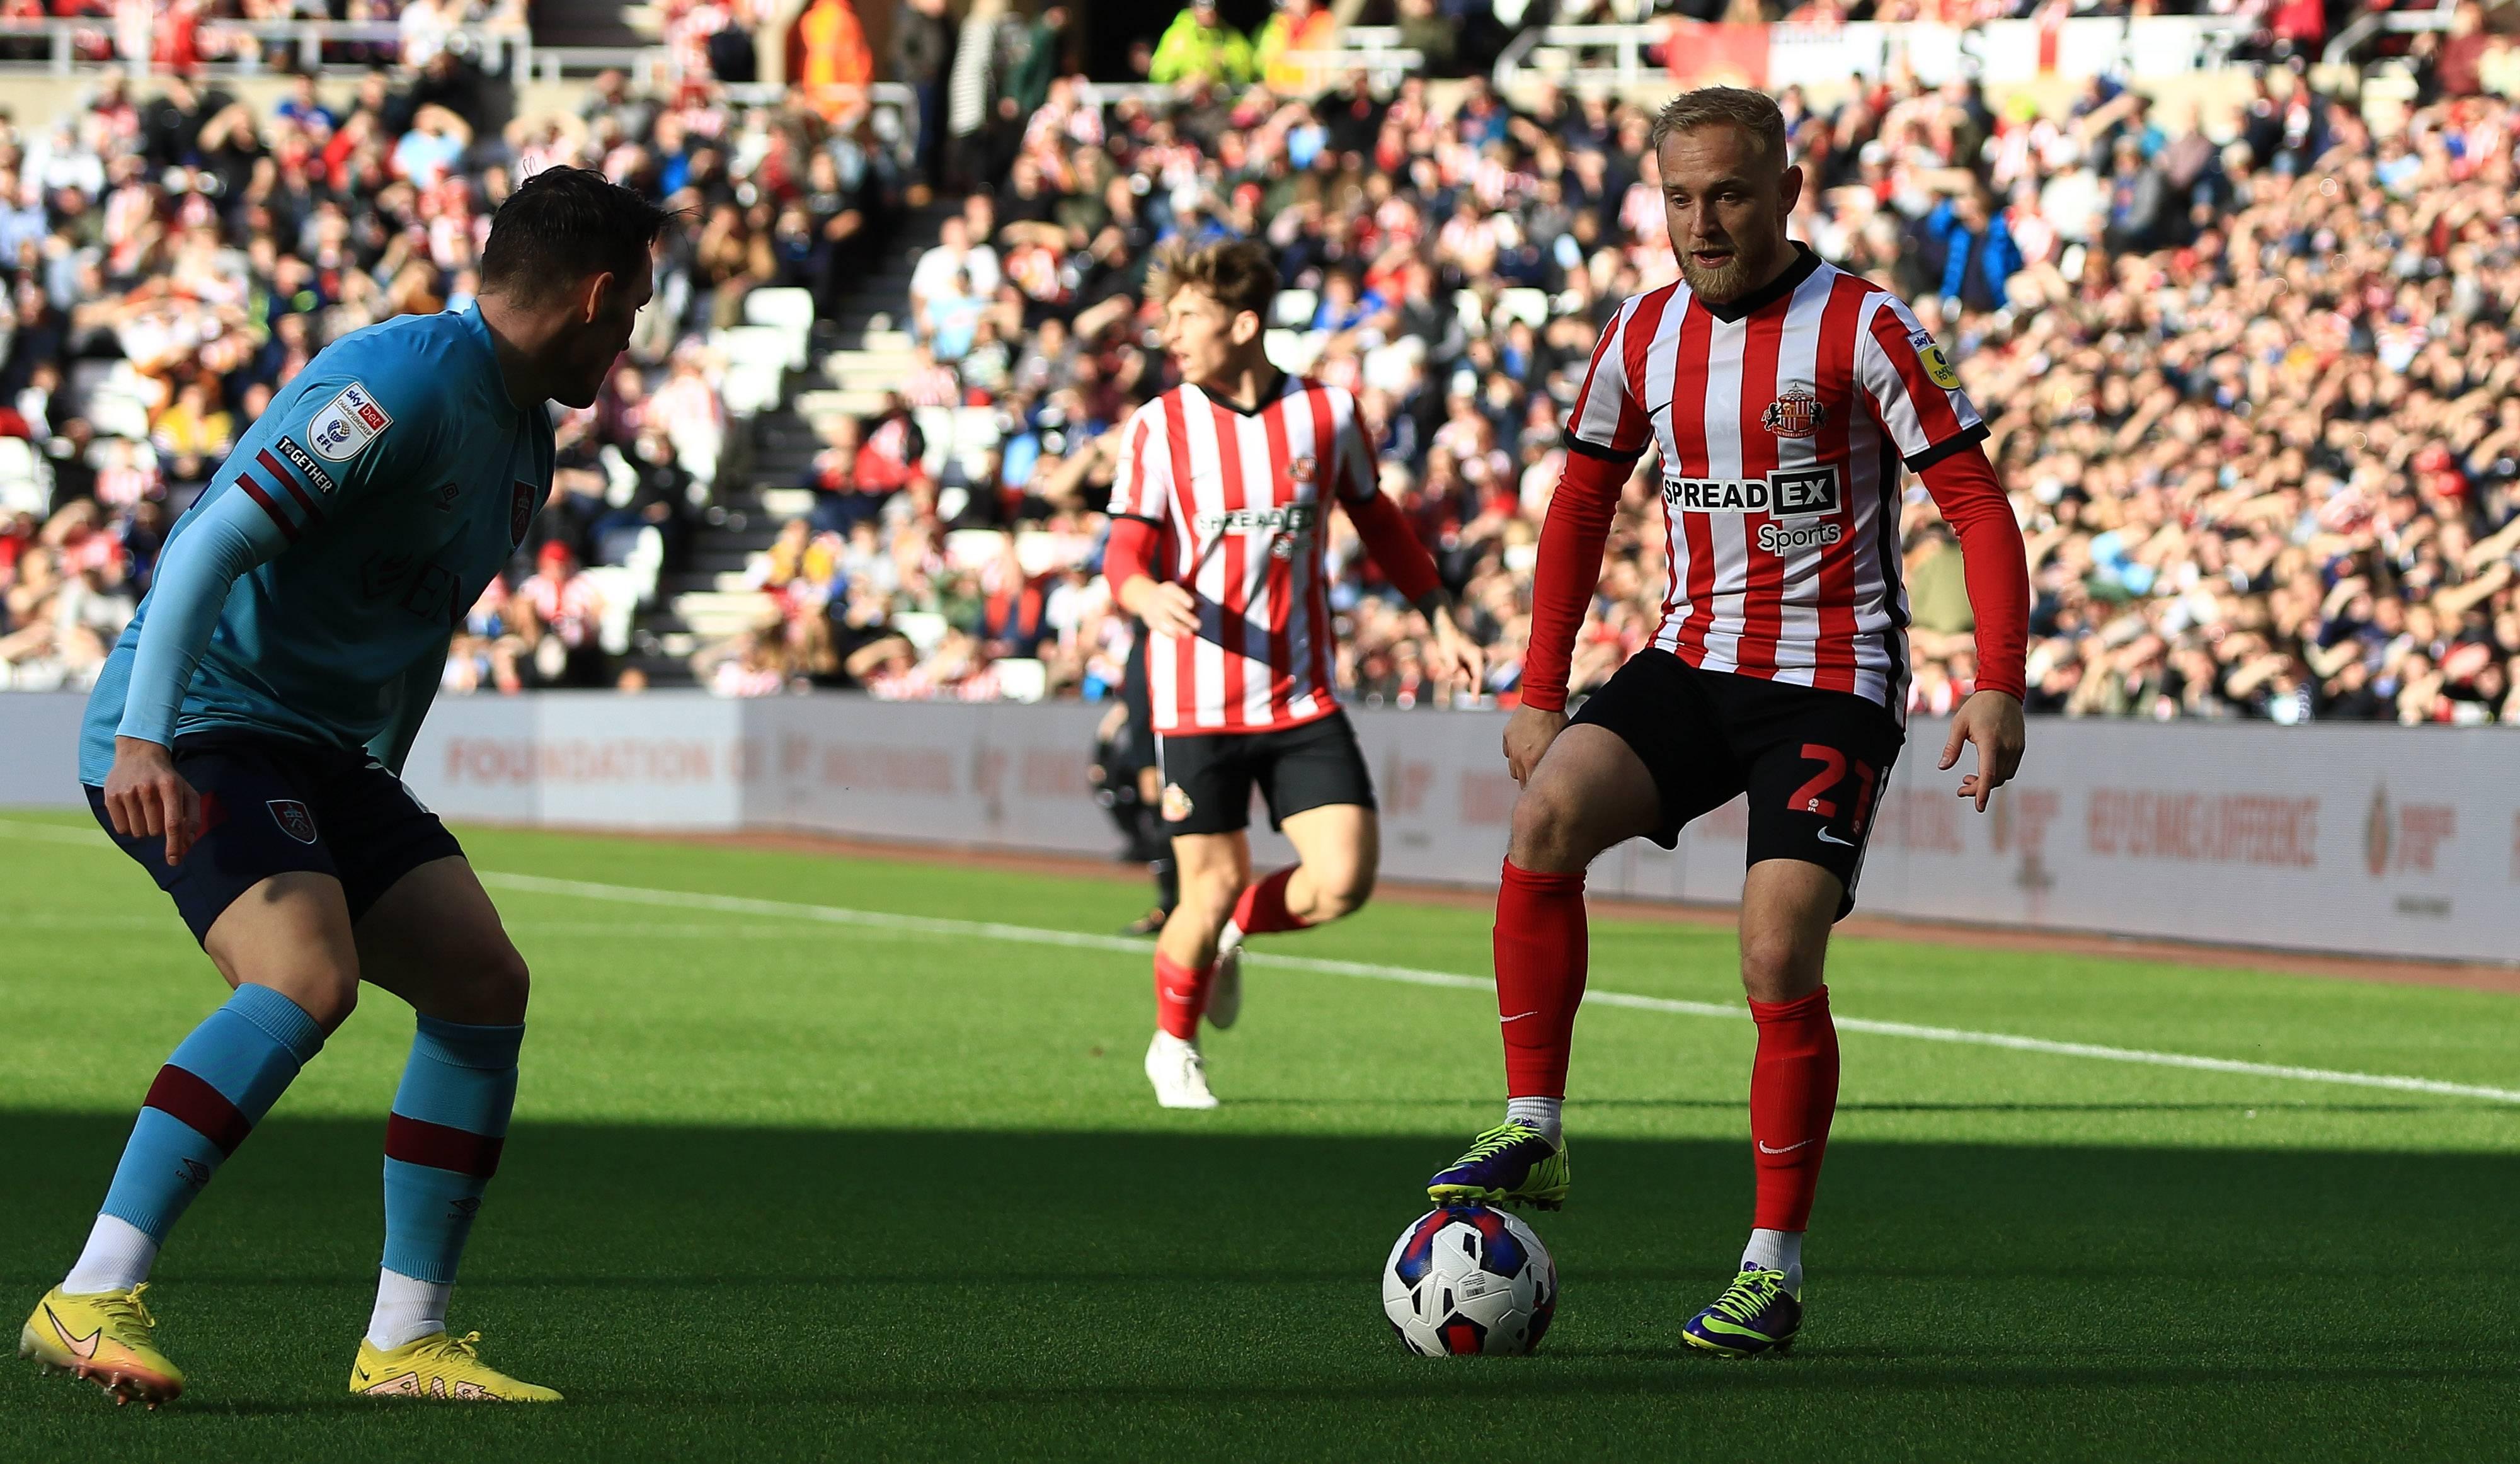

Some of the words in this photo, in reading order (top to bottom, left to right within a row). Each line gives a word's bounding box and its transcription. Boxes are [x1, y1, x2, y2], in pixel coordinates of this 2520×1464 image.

[1914, 336, 1928, 348] sky
[337, 399, 372, 437] CHAMPIONSHIP
[346, 390, 365, 407] sky
[362, 405, 381, 426] bet
[316, 433, 333, 453] EFL
[1760, 525, 1840, 554] Sports
[1787, 743, 1875, 836] 21
